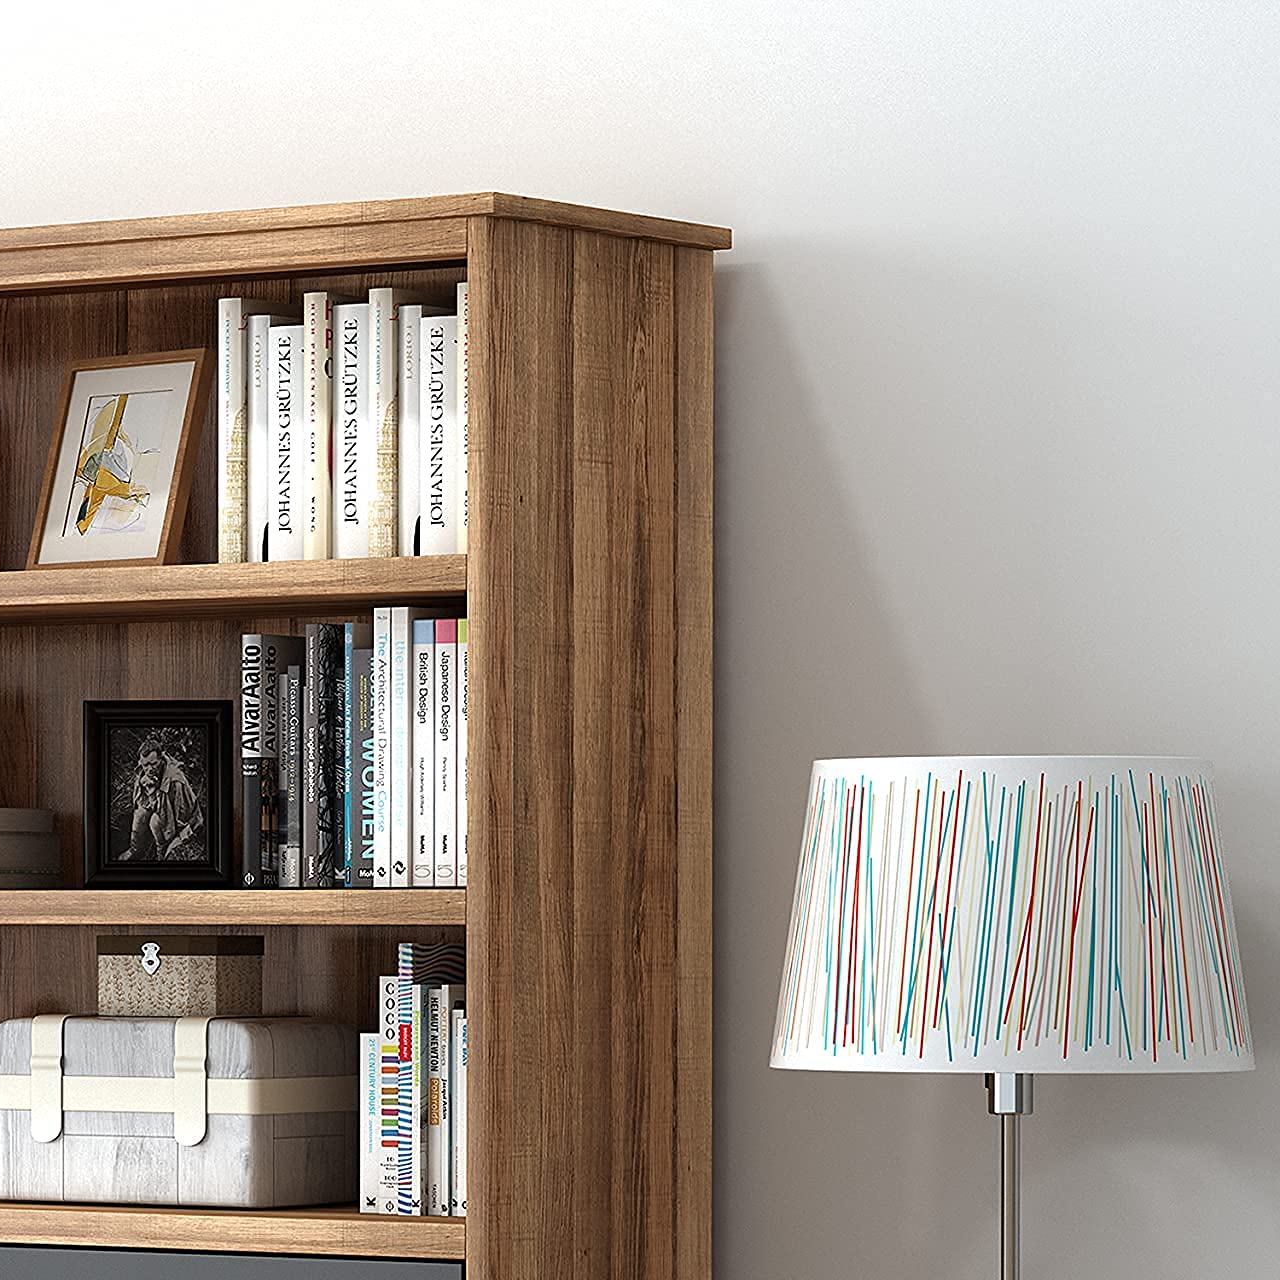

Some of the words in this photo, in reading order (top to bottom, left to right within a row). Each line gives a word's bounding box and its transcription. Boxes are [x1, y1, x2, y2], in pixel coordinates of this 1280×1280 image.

[276, 335, 291, 428] GRÜTZKE
[342, 318, 357, 415] GRÜTZKE
[428, 326, 443, 420] GRÜTZKE
[278, 432, 293, 534] JOHANNES
[344, 418, 359, 525] JOHANNES
[430, 424, 445, 528] JOHANNES
[378, 633, 388, 657] The
[394, 639, 407, 664] the
[418, 652, 429, 686] British
[439, 651, 452, 703] Japanese
[288, 679, 299, 714] Picasso
[378, 659, 388, 734] Architectural
[417, 687, 429, 724] Design
[288, 716, 299, 756] Guitars
[438, 704, 451, 742] Design
[376, 739, 388, 787] Drawing
[378, 790, 388, 832] Course
[385, 982, 395, 1041] COCO
[430, 997, 439, 1032] HELMUT
[368, 1052, 376, 1088] CENTURY
[430, 1034, 439, 1072] NEWTON
[368, 1089, 376, 1116] HOUSE
[431, 1079, 440, 1125] Polaroids
